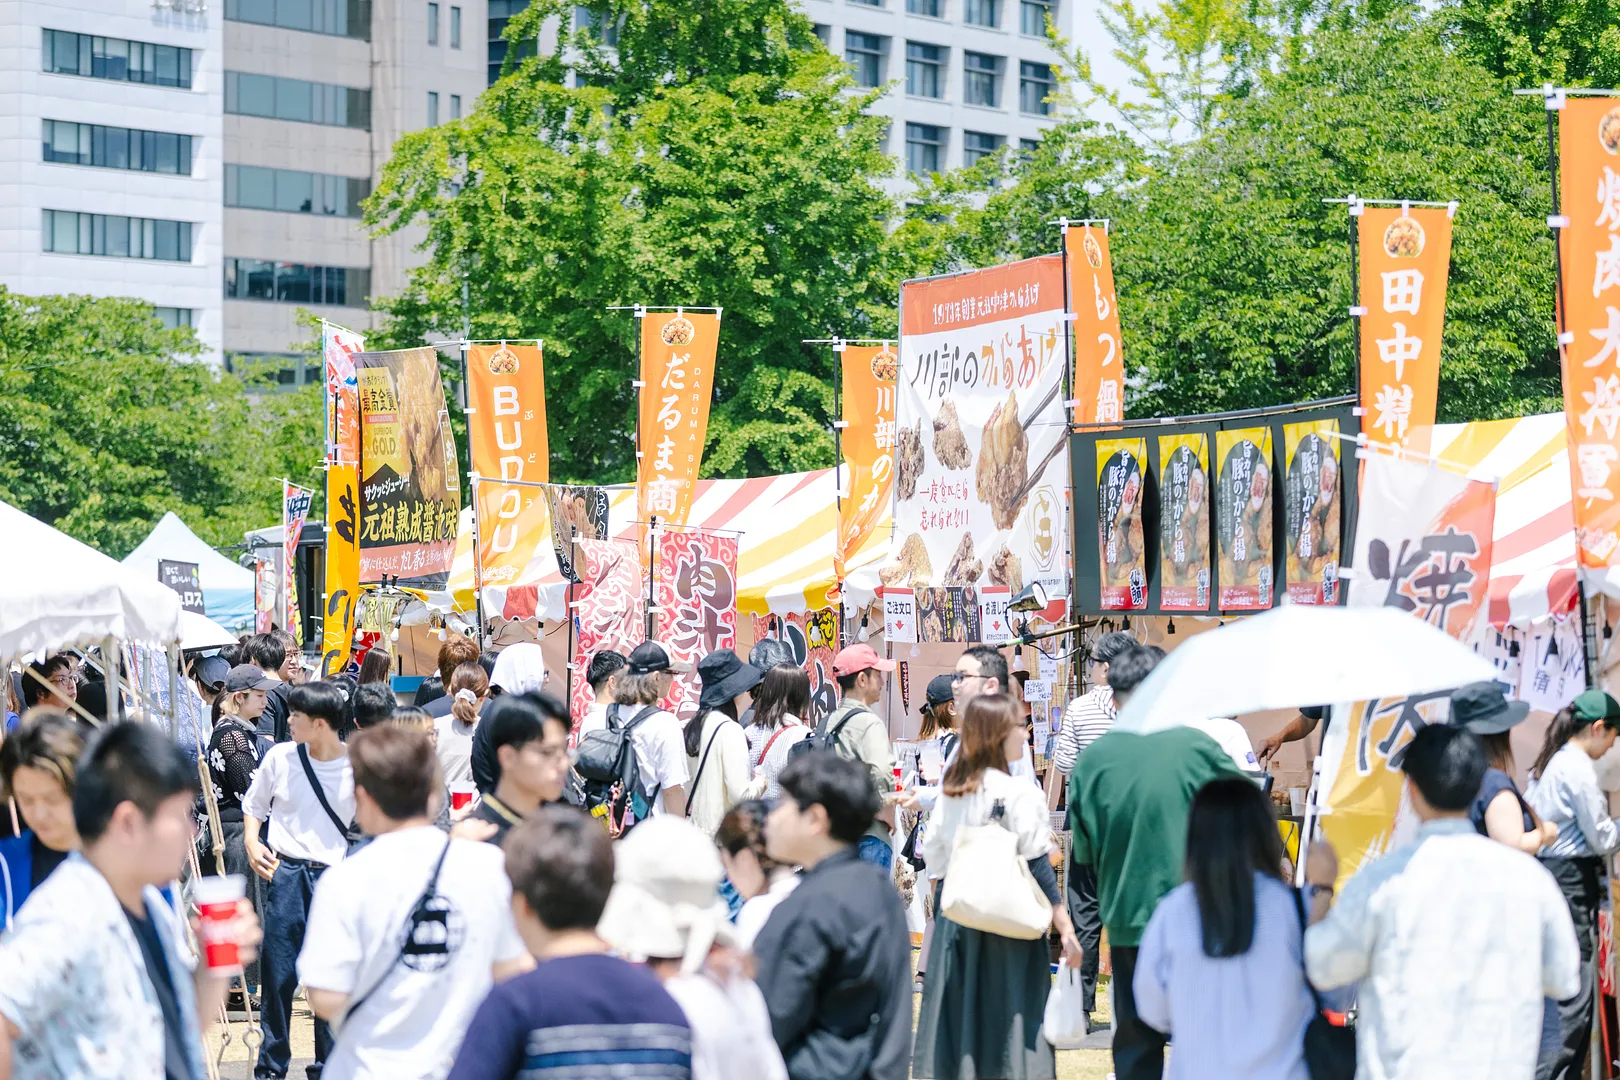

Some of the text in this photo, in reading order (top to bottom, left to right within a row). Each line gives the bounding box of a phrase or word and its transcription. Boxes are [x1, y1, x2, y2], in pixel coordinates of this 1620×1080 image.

[1094, 273, 1119, 423] もつ鍋
[1373, 268, 1425, 452] 田中精
[688, 367, 702, 442] DARUMA
[372, 437, 397, 456] GOLD
[491, 385, 525, 553] BUDOU
[523, 409, 537, 509] ぶどう
[920, 506, 969, 531] 忘れられない
[179, 591, 204, 607] ュロス
[887, 601, 912, 616] ご注文口
